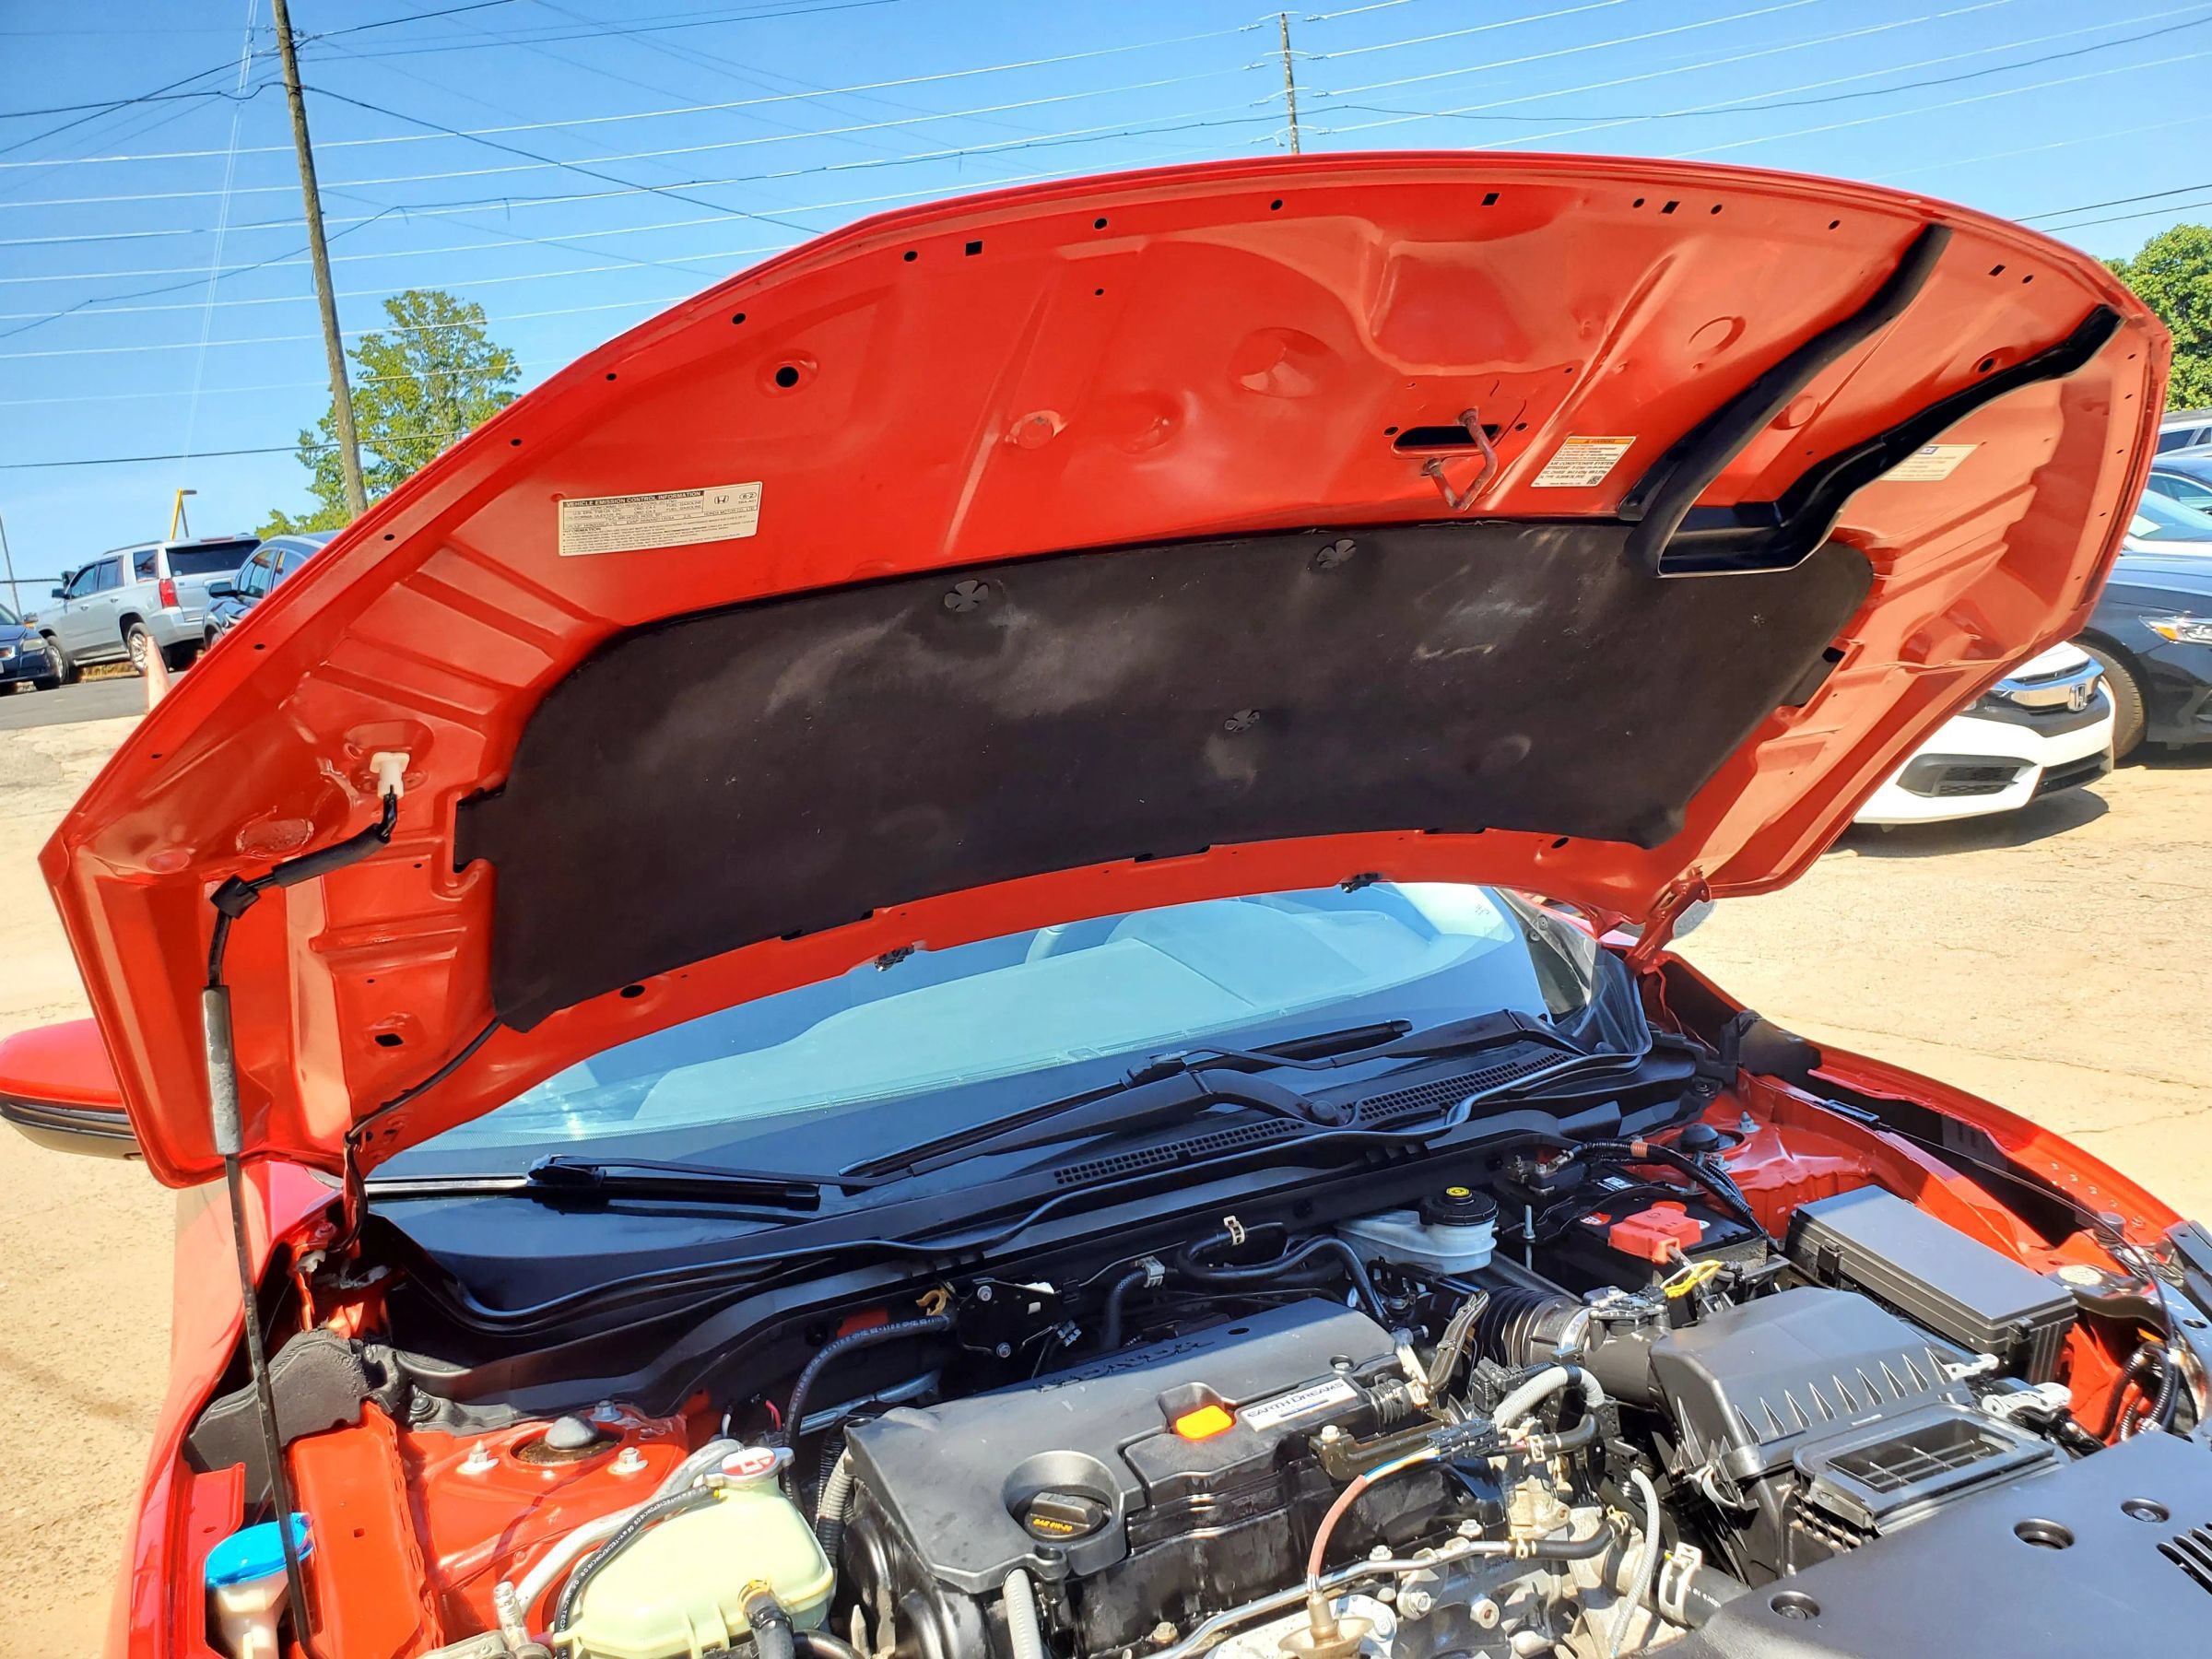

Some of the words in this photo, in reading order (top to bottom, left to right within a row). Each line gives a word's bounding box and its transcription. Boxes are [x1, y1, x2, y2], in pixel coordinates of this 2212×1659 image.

[595, 498, 626, 506] EMISSION
[627, 496, 655, 504] CONTROL
[657, 491, 701, 500] INFORMATION
[1247, 1397, 1290, 1418] EARTH
[1291, 1382, 1345, 1403] DREAMS
